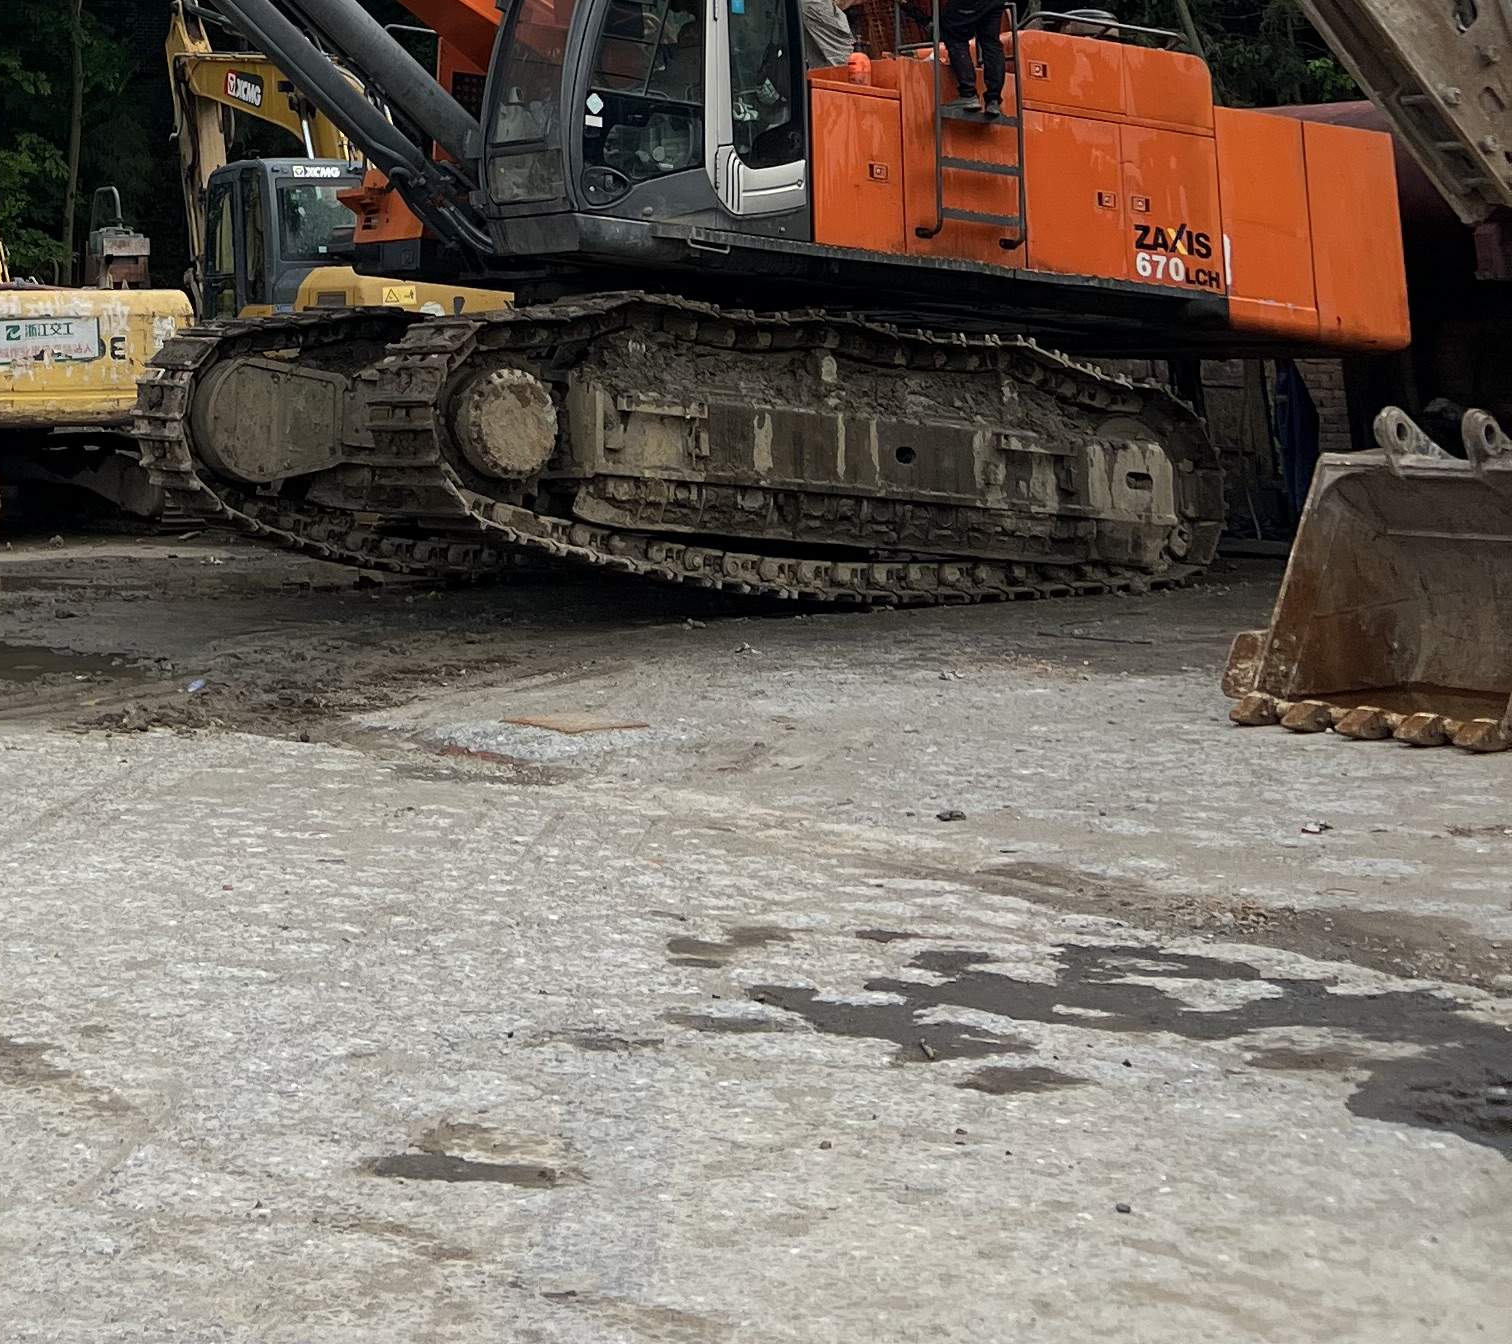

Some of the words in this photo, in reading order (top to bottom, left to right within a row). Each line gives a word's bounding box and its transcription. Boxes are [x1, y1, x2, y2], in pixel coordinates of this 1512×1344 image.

[235, 78, 261, 106] XCMG
[305, 166, 340, 178] XCMG
[1134, 223, 1212, 259] ZAXIS
